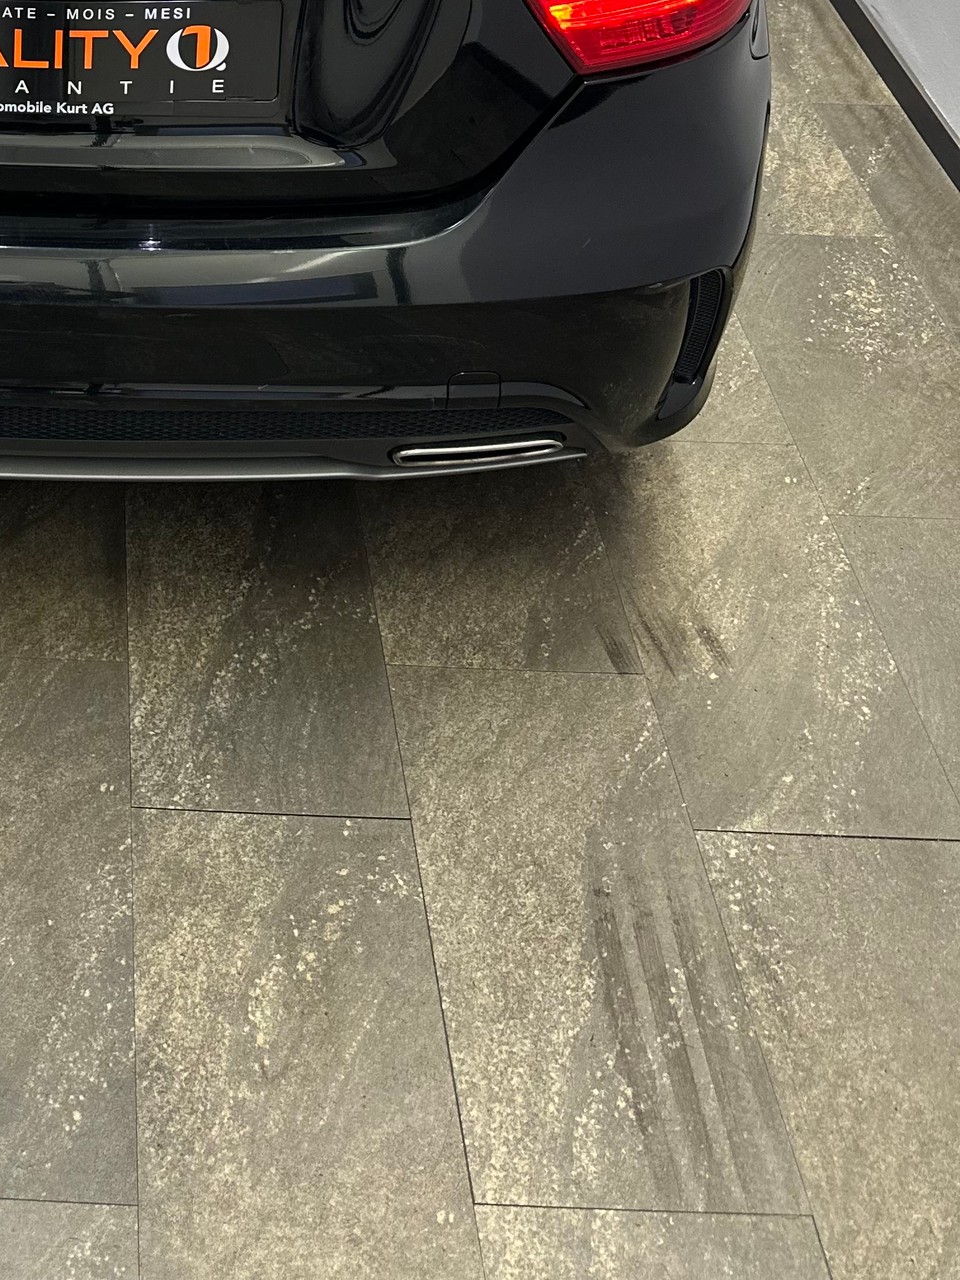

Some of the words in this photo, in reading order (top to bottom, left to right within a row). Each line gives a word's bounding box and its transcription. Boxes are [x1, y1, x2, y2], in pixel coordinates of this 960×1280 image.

[66, 8, 115, 20] MOIS
[144, 7, 191, 20] MESI
[56, 101, 87, 115] Kurt
[90, 102, 114, 115] AG
